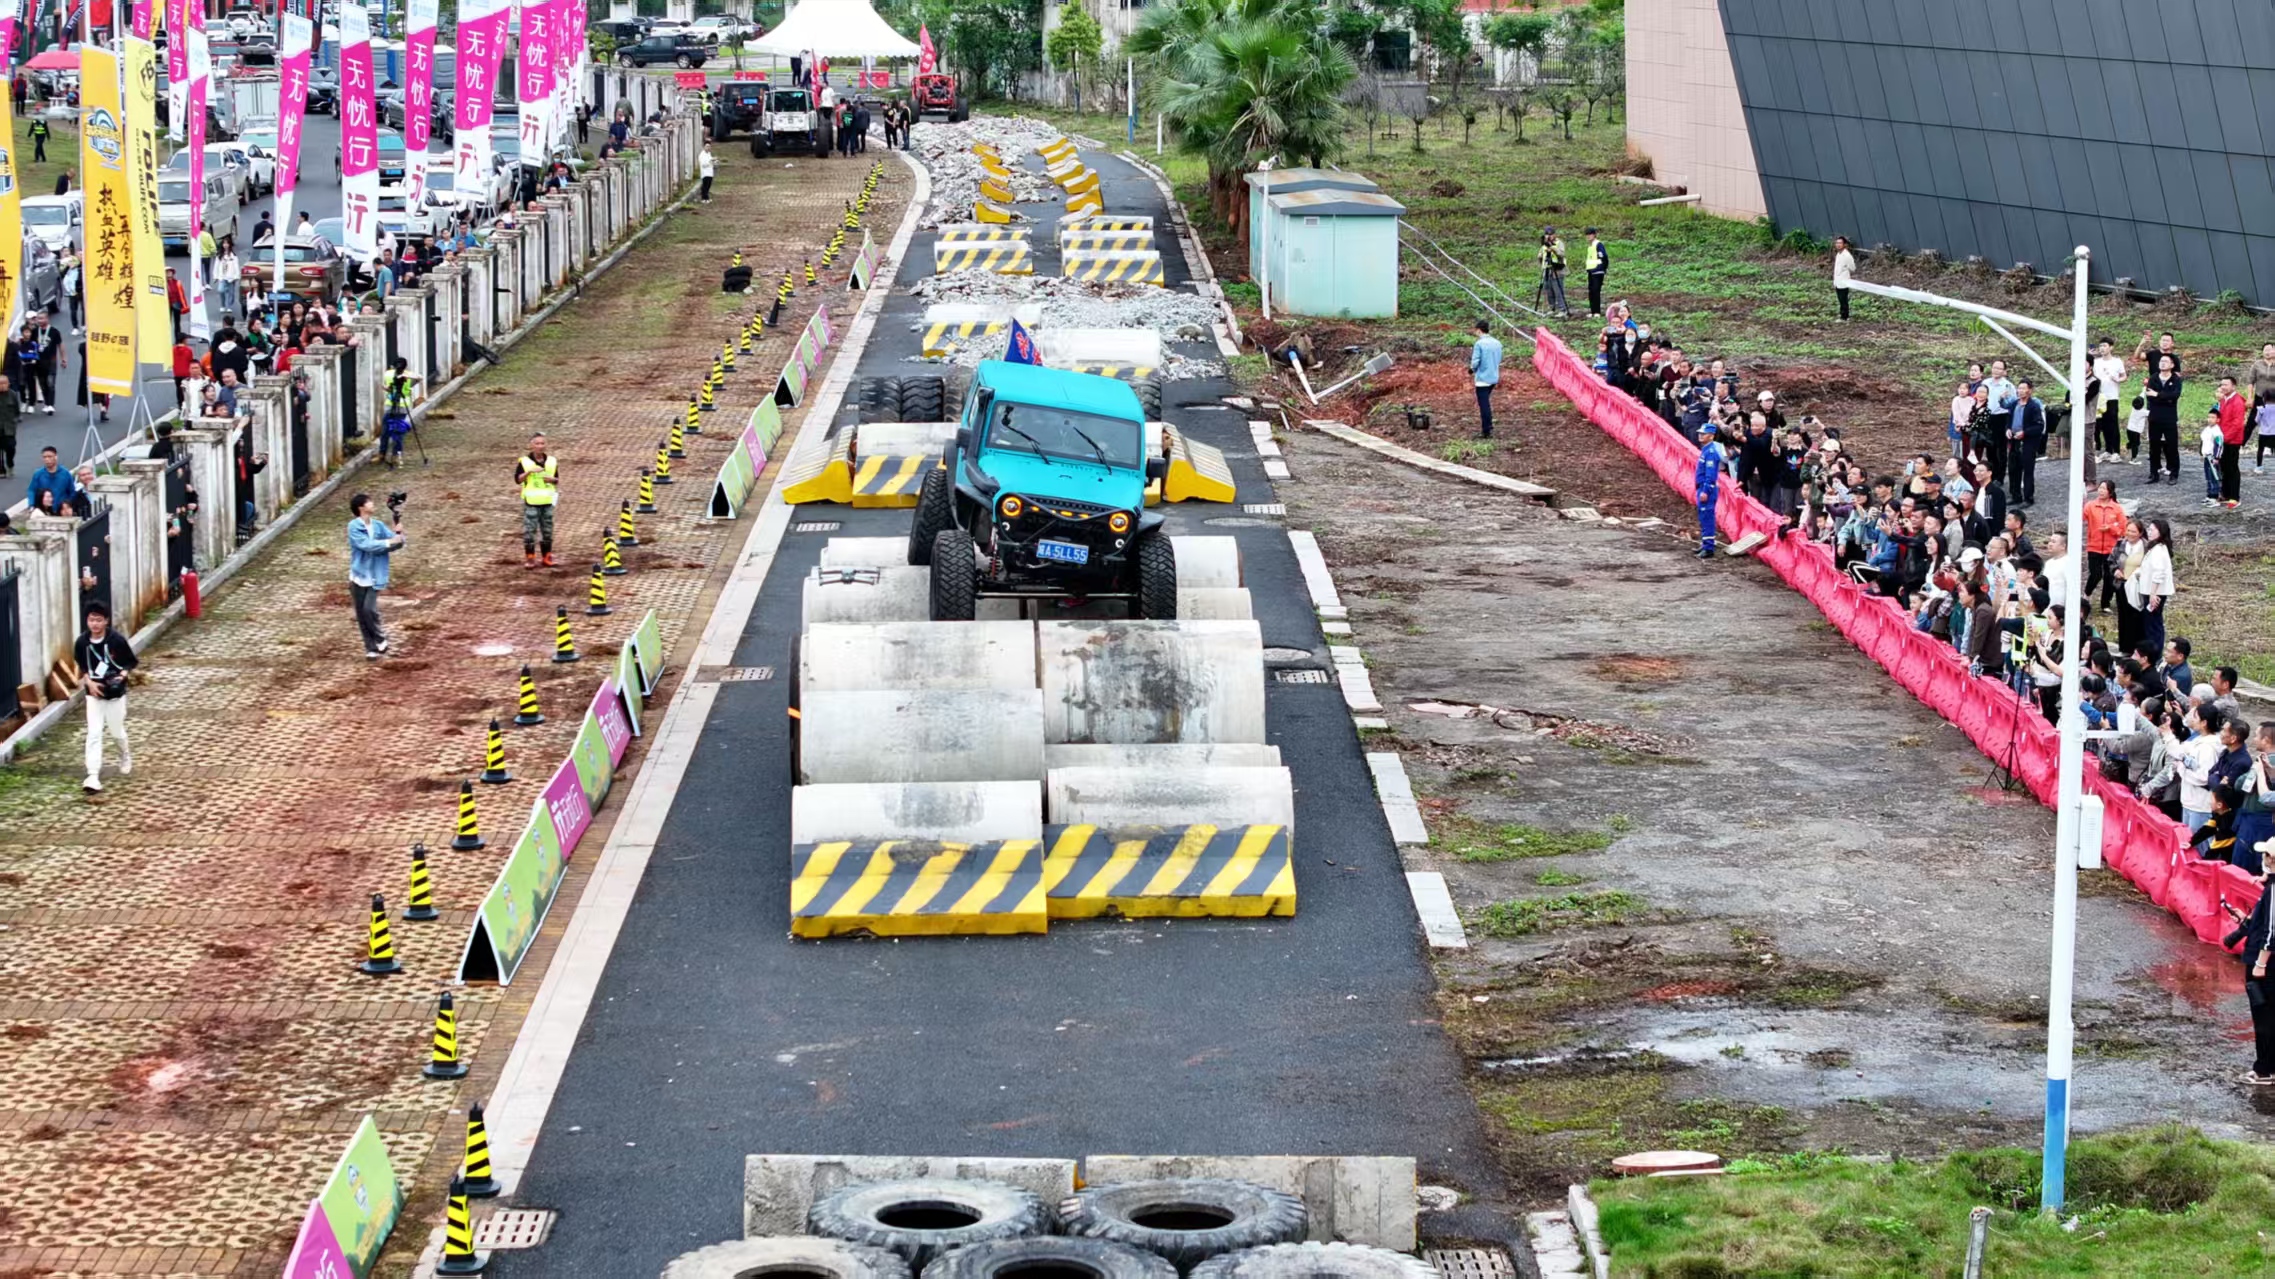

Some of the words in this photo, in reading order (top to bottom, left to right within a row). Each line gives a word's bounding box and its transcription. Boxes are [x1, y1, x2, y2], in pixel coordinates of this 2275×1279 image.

[410, 42, 427, 150] 无忧行
[464, 29, 486, 123] 无忧行
[526, 14, 548, 96] 无忧行
[276, 68, 304, 188] 无忧行
[347, 57, 372, 167] 无忧行
[94, 183, 118, 283] 热血英雄
